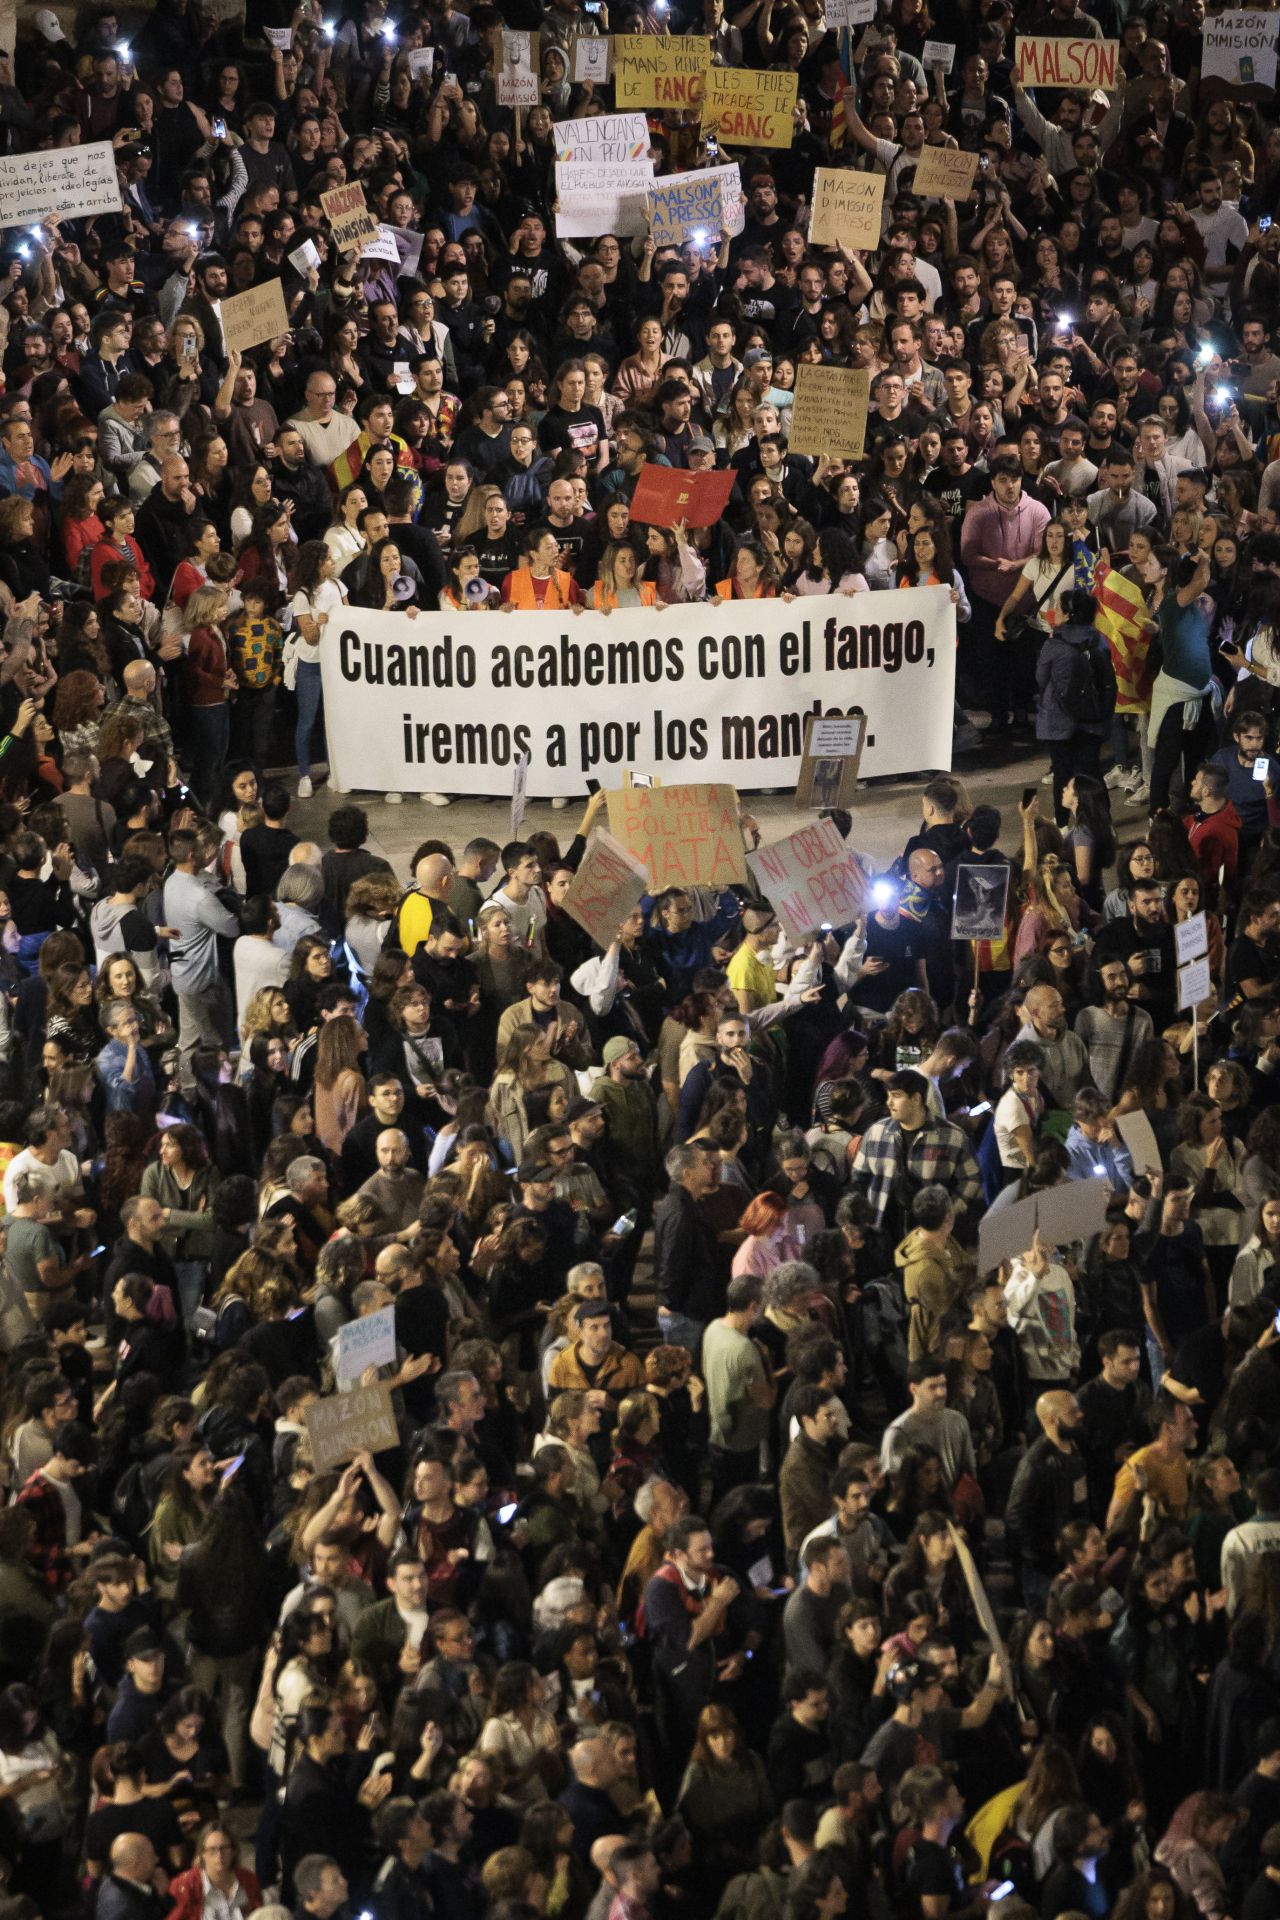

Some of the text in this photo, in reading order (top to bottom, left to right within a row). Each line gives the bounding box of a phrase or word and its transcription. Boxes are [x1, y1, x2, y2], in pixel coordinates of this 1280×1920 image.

[1214, 16, 1267, 30] MAZÓN
[623, 37, 706, 52] LES NOSTRES
[1206, 32, 1276, 49] DIMISIÓN
[622, 55, 708, 75] MANS PLENES
[1020, 41, 1115, 87] MALSON
[502, 75, 534, 88] MAZÓN
[624, 82, 641, 98] DE
[714, 71, 795, 94] LES TEUES
[500, 90, 537, 102] DIMISSIÓ
[712, 92, 789, 114] TACADES DE
[556, 116, 646, 144] VALENCIANS
[719, 112, 775, 139] SANG
[24, 160, 54, 172] dejes
[62, 156, 79, 170] que
[88, 151, 106, 160] nos
[84, 165, 98, 176] de
[824, 179, 876, 197] MAZÓN
[86, 192, 118, 206] arriba
[653, 212, 664, 226] A
[819, 214, 828, 225] A
[800, 368, 812, 378] LA
[824, 428, 840, 438] NOS
[340, 618, 936, 688] Cuando acabemos con el fango,
[403, 714, 532, 766] iremos
[546, 724, 566, 768] a
[580, 718, 640, 772] por
[654, 710, 708, 762] los
[624, 784, 721, 812] LA MALA
[625, 808, 734, 839] POLITICA
[628, 837, 740, 890] MATA
[758, 848, 790, 884] NI
[781, 891, 814, 932] NI
